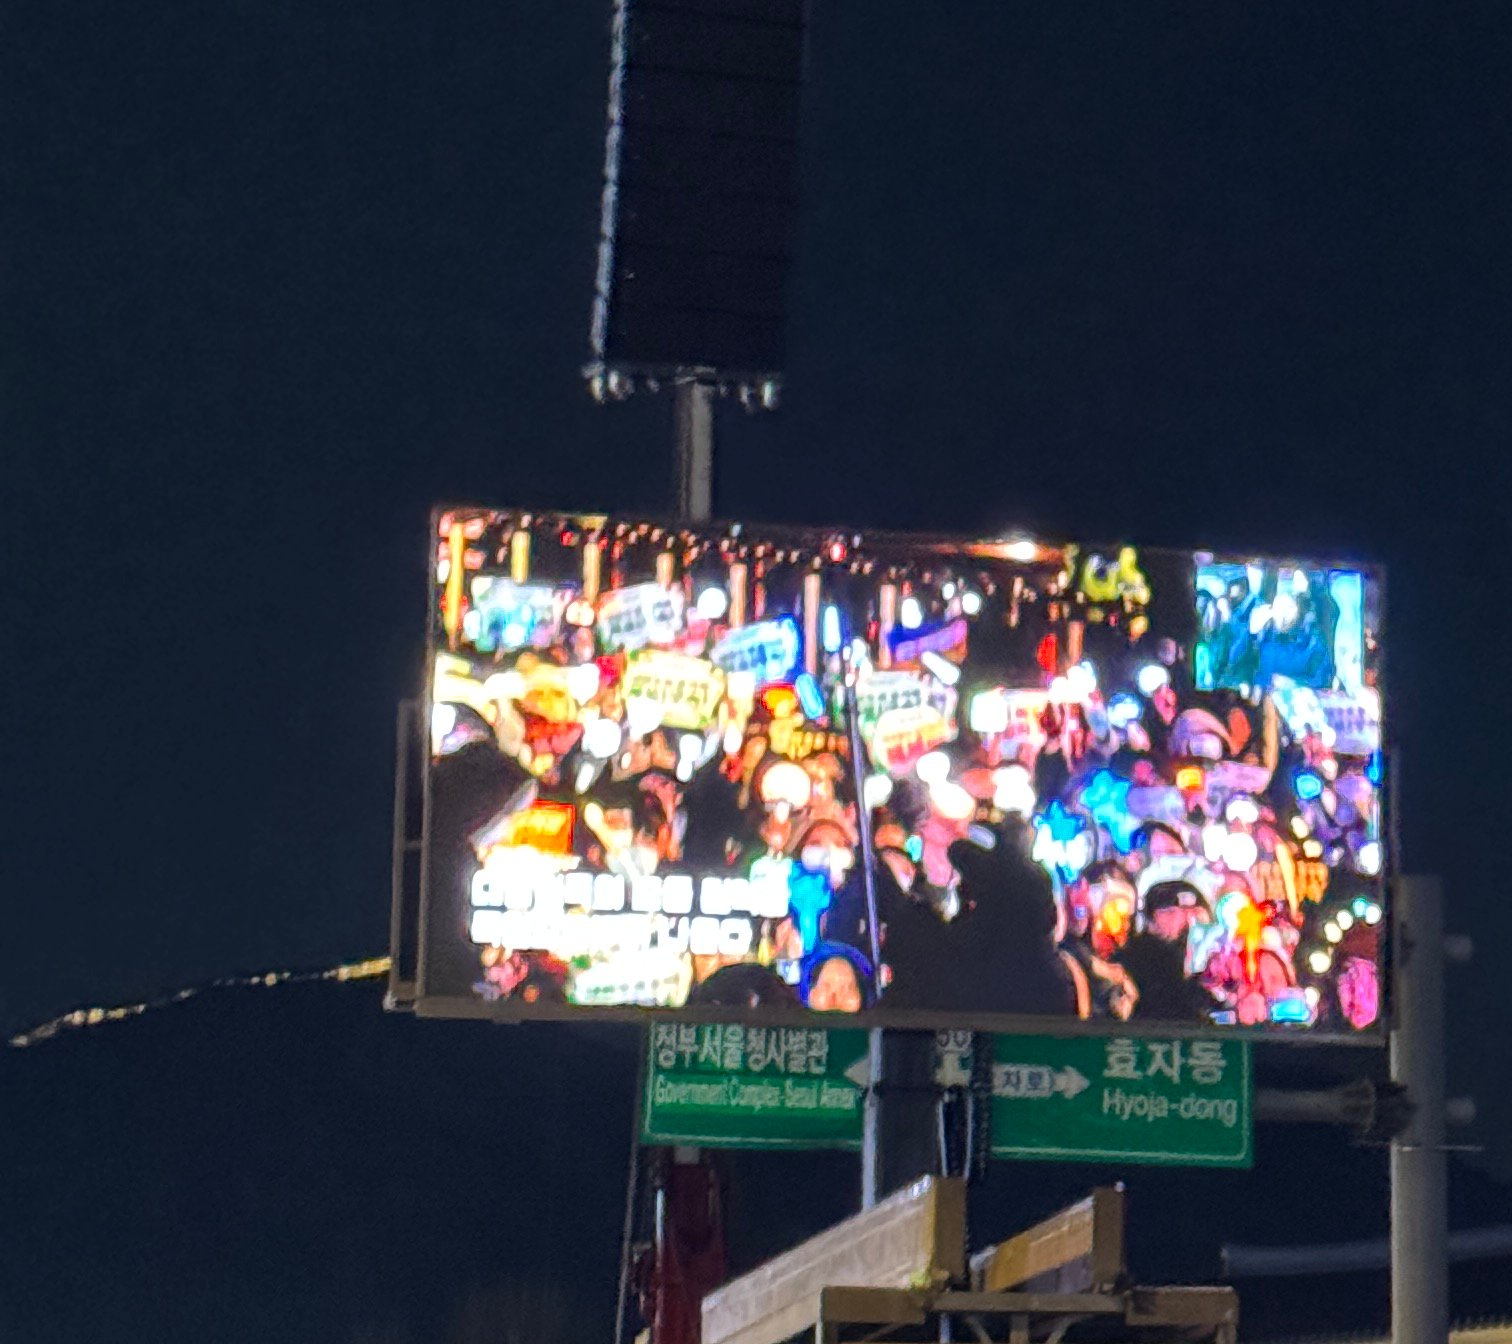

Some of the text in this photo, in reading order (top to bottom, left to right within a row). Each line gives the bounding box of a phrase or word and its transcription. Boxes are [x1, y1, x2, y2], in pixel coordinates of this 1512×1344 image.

[1002, 1070, 1044, 1092] 자로
[1103, 1038, 1227, 1085] 효자동
[1103, 1088, 1238, 1128] Hyoja-dong
